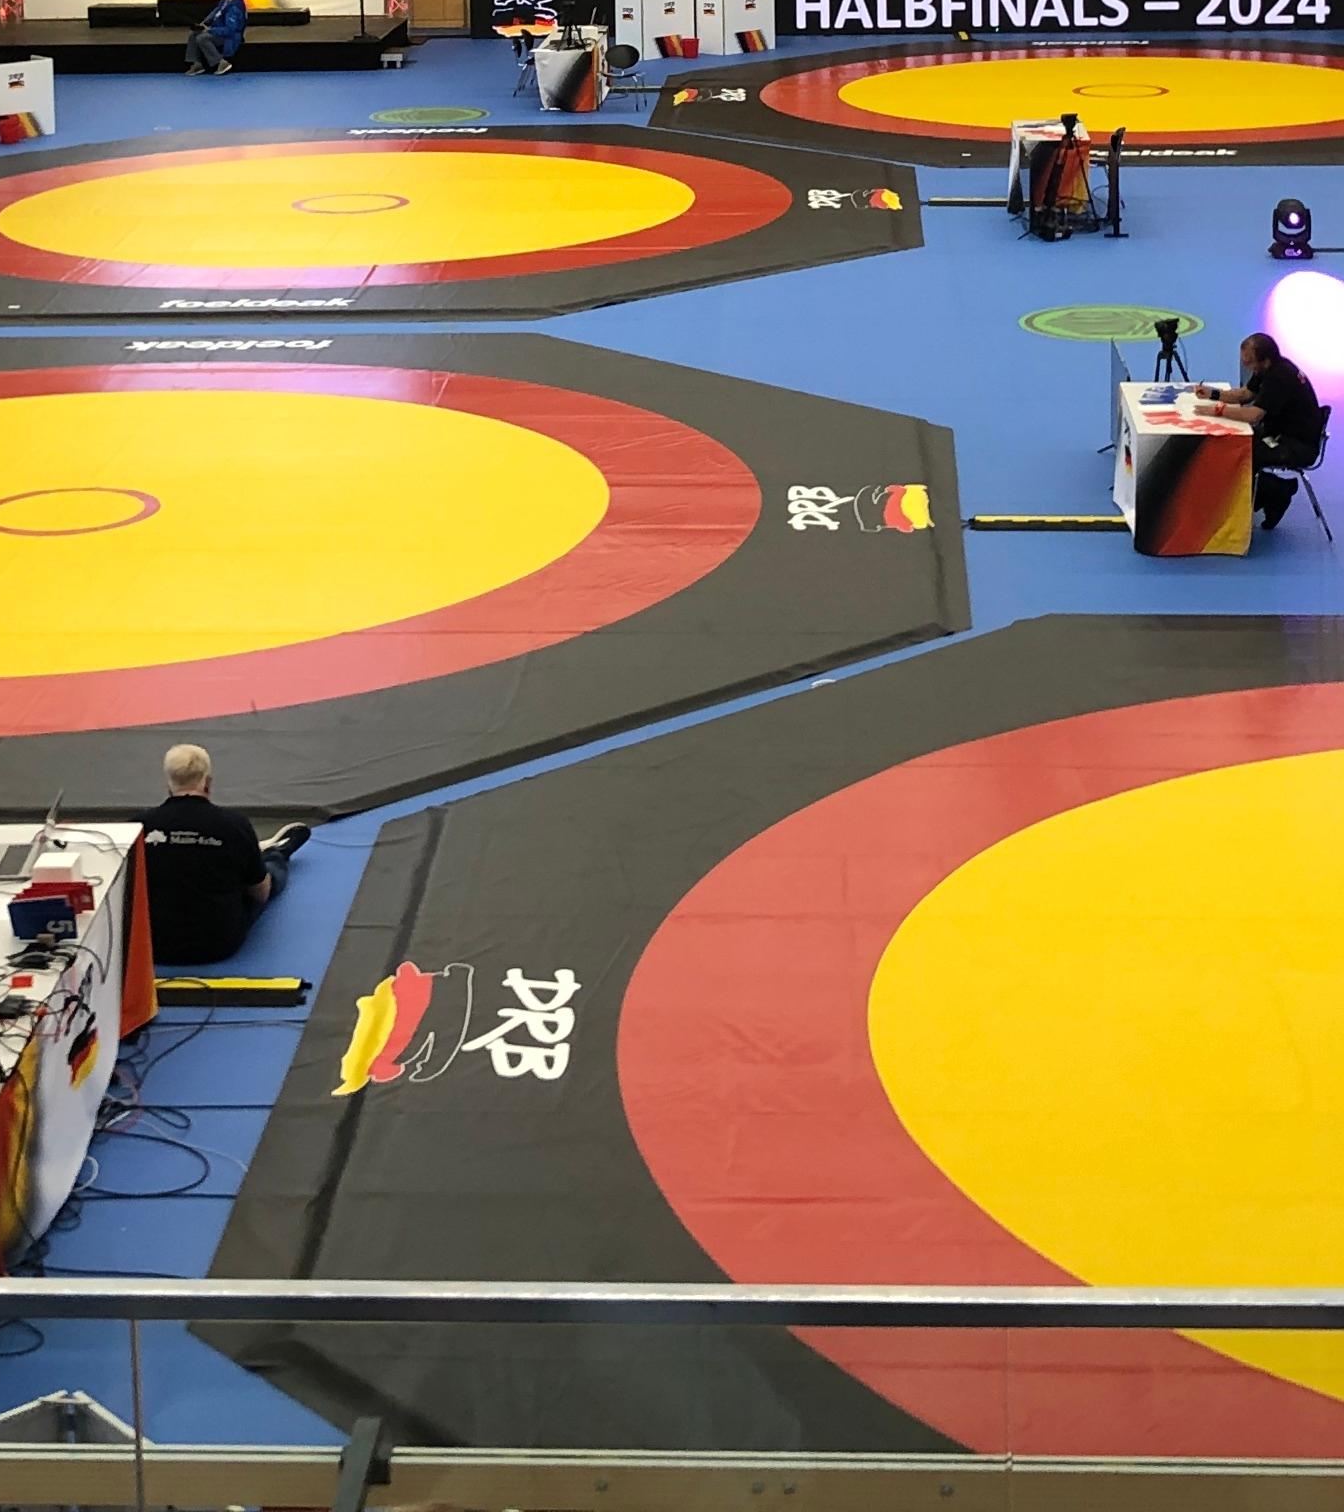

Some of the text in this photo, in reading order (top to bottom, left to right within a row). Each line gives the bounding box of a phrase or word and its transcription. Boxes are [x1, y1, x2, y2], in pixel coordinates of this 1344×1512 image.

[159, 297, 357, 309] foeldeak
[787, 485, 855, 531] DRB
[461, 968, 582, 1080] DRB
